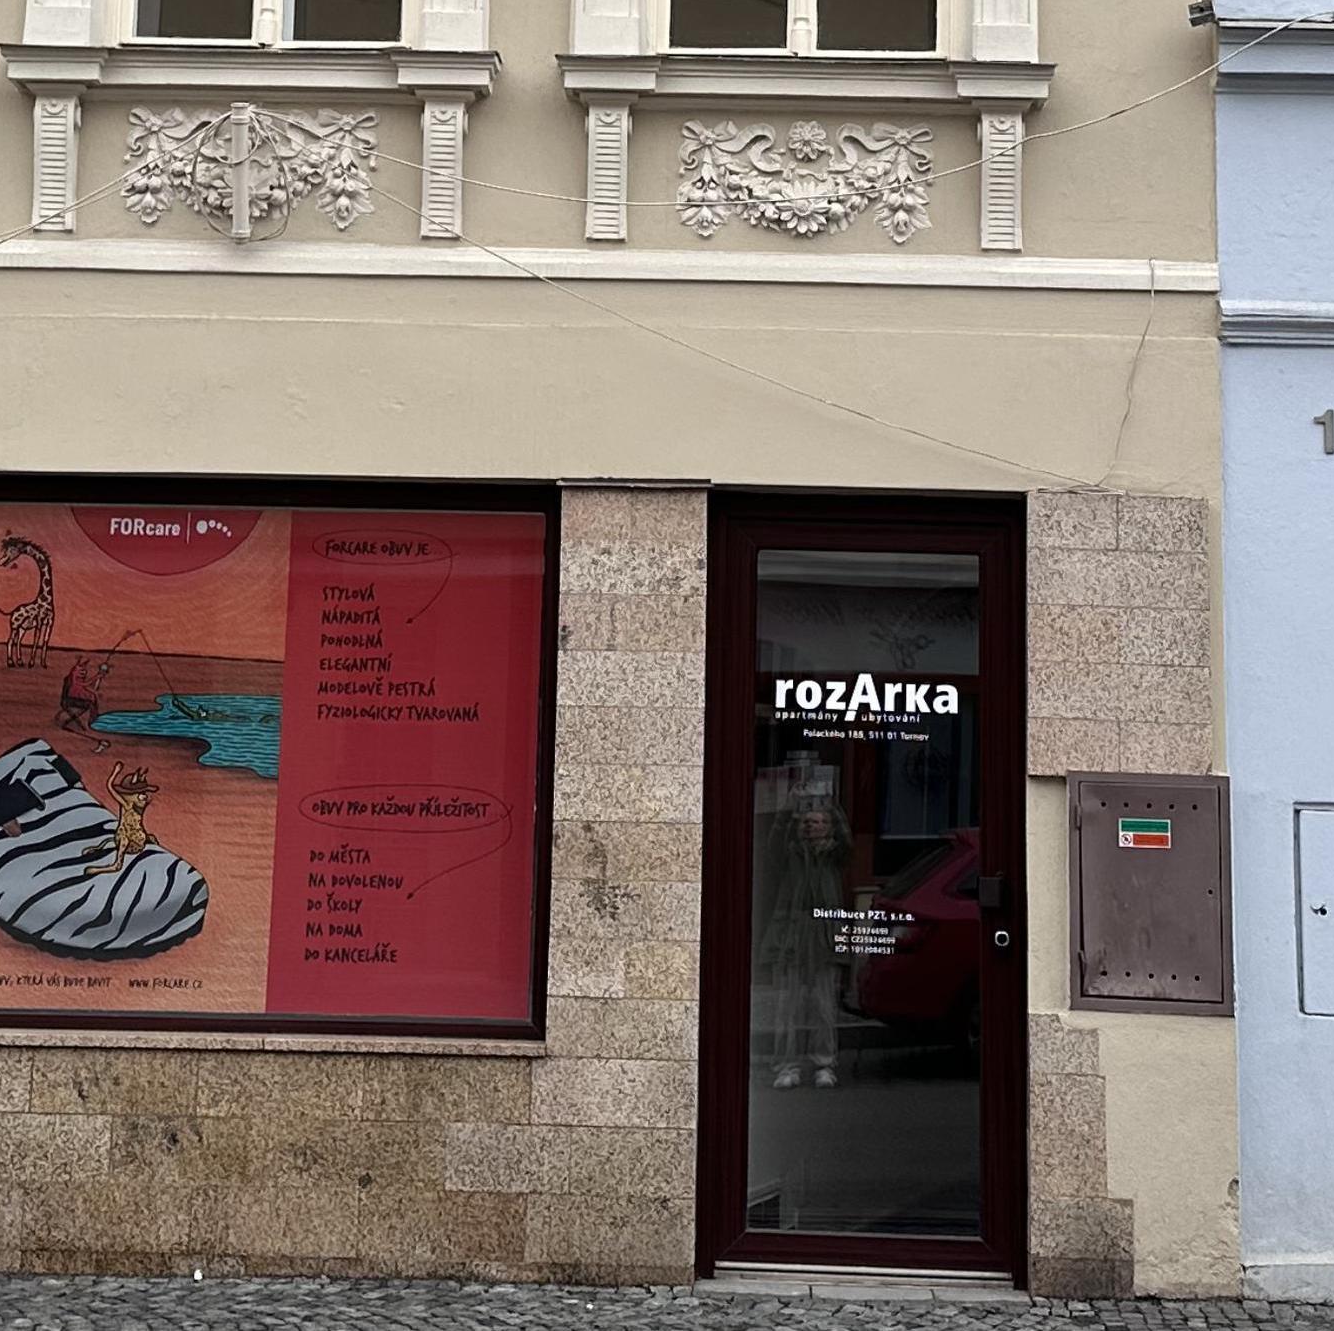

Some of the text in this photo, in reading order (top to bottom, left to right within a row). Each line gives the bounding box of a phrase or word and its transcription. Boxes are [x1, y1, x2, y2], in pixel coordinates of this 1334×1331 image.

[109, 517, 181, 536] FORcare
[325, 539, 376, 557] FORCARE
[381, 540, 413, 557] OBUV
[322, 582, 376, 602] STYLOVÁ
[321, 604, 381, 625] NÁPADITÁ
[320, 629, 384, 649] POHODLNÁ
[319, 652, 394, 673] ELEGANTNÍ
[317, 676, 436, 697] MODELOVĚ PESTRÁ
[317, 702, 480, 721] FYZIOLOGICKY TVAROVANÁ
[775, 710, 920, 724] apartmány ubytování
[868, 730, 884, 740] 511
[887, 731, 898, 740] 01
[312, 795, 490, 818] OBUV PRO KAŽDOU PŘÍLEŽITOST
[309, 842, 371, 864] DO MĚSTA
[308, 872, 404, 889] NA DOVOLENOU
[307, 892, 363, 913] DO ŠKOLY
[813, 908, 865, 920] Distribuce
[305, 922, 363, 938] NA DOMA
[304, 942, 398, 963] DO KANCELÁŘE
